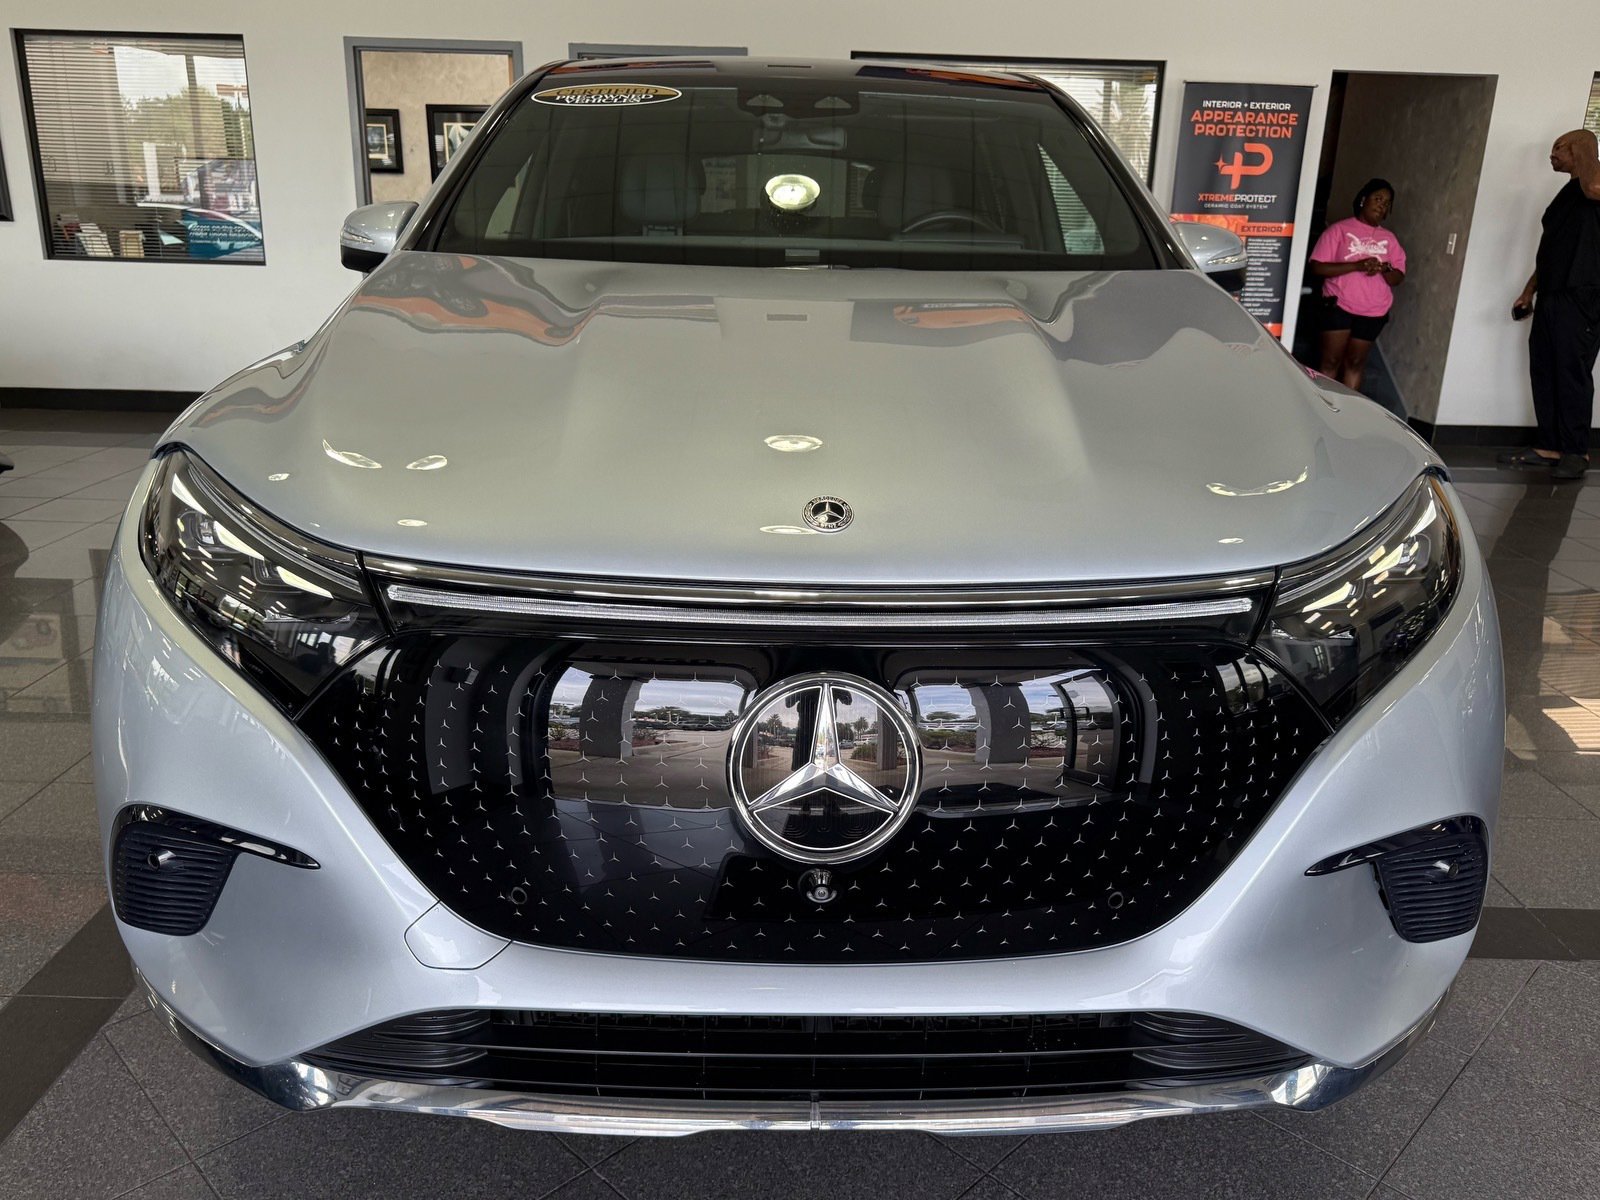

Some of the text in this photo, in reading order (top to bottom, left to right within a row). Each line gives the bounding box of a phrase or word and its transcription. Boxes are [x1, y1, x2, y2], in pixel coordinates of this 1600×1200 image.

[1202, 100, 1242, 109] INTERIOR
[1250, 101, 1291, 110] EXTERIOR
[1190, 110, 1298, 125] APPEARANCE
[1194, 124, 1292, 138] PROTECTION
[1198, 193, 1277, 203] XTREMEPROTECT
